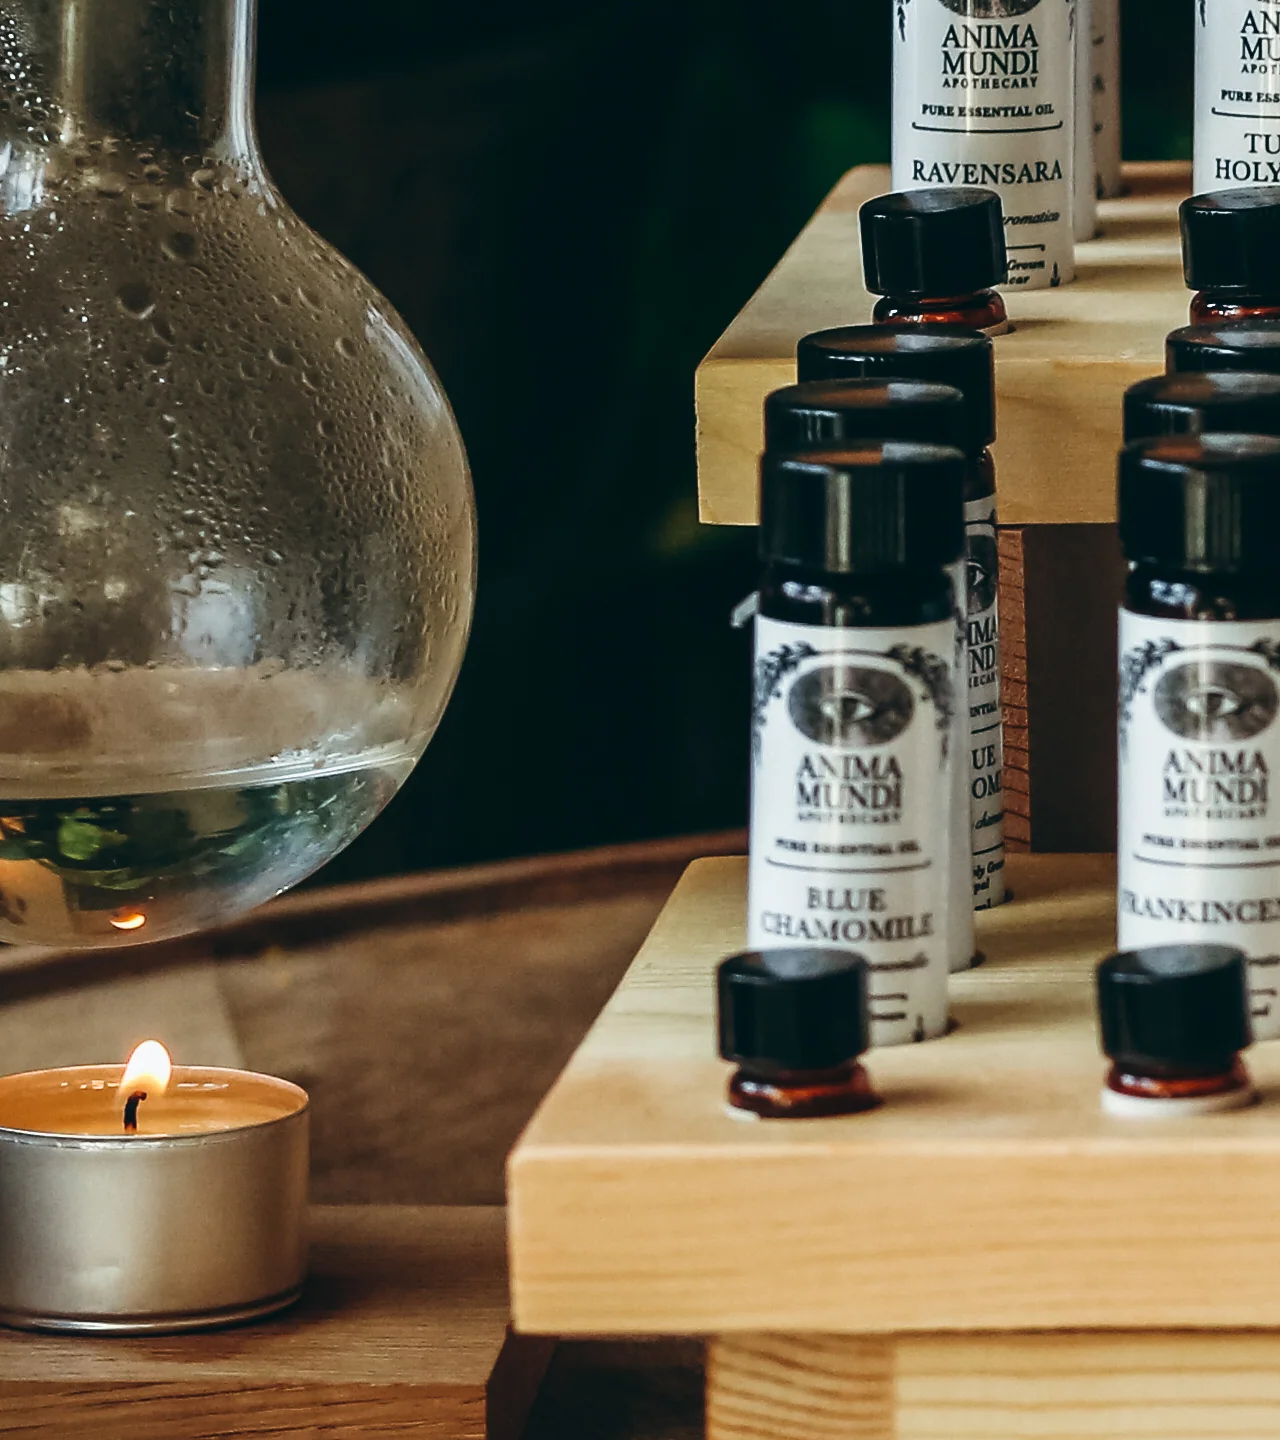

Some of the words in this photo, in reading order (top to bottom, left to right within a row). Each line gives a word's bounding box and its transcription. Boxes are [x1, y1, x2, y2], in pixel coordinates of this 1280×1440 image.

[941, 24, 1039, 48] ANIMA
[942, 50, 1039, 75] MUNDI
[942, 77, 1037, 89] APOTHECARY
[1221, 90, 1252, 101] PURE
[922, 104, 954, 116] PURE
[958, 106, 1029, 117] ESSENTIAL
[1036, 104, 1054, 115] OIL
[912, 160, 1062, 184] RAVENSARA
[797, 755, 901, 778] ANIMA
[1164, 750, 1269, 774] ANIMA
[797, 782, 901, 809] MUNDI
[1164, 777, 1268, 803] MUNDI
[807, 887, 886, 911] BLUE
[761, 910, 934, 942] CHAMOMILE
